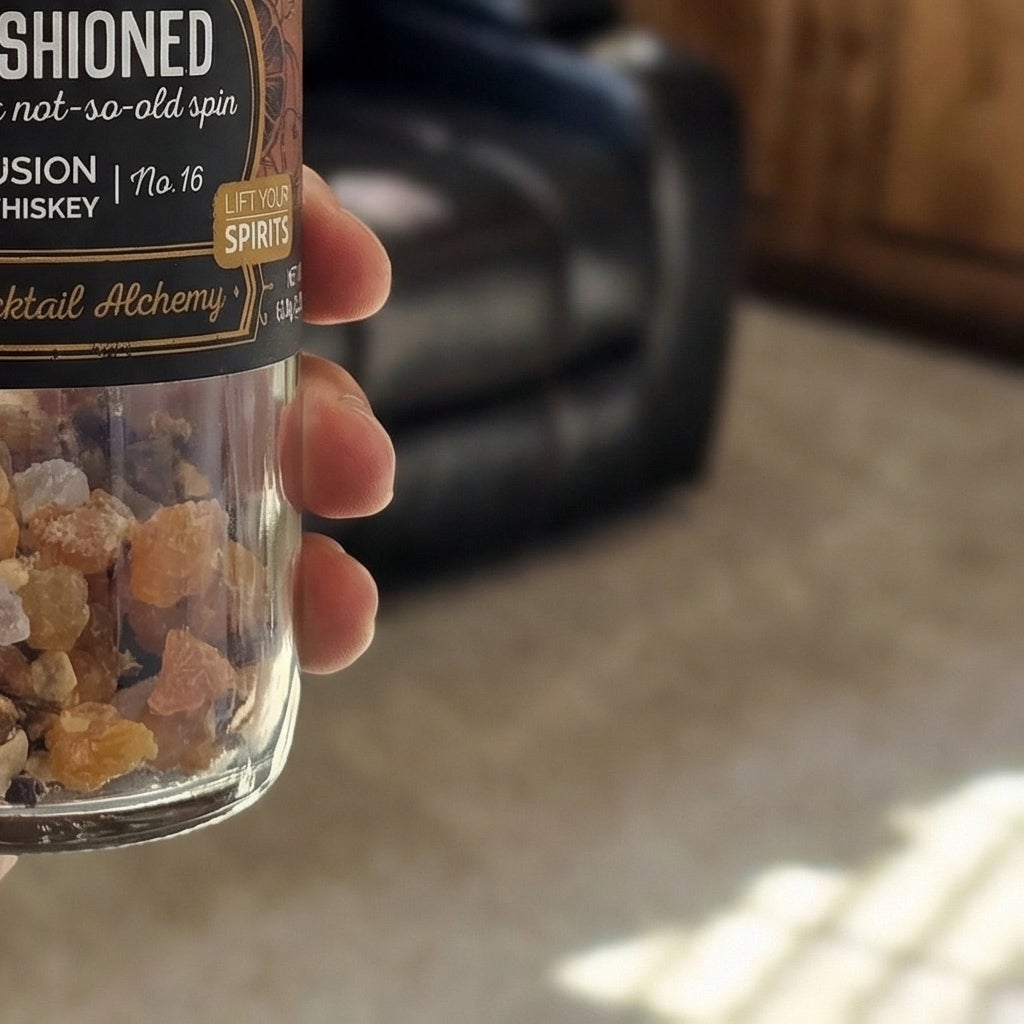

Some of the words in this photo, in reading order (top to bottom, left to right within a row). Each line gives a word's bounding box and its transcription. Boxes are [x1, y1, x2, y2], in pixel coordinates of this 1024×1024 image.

[11, 86, 184, 122] not-so-old
[189, 89, 238, 129] spin
[225, 190, 256, 214] LIFT
[258, 184, 289, 209] YOUR
[225, 215, 289, 254] SPIRITS
[94, 282, 226, 323] Alchemy
